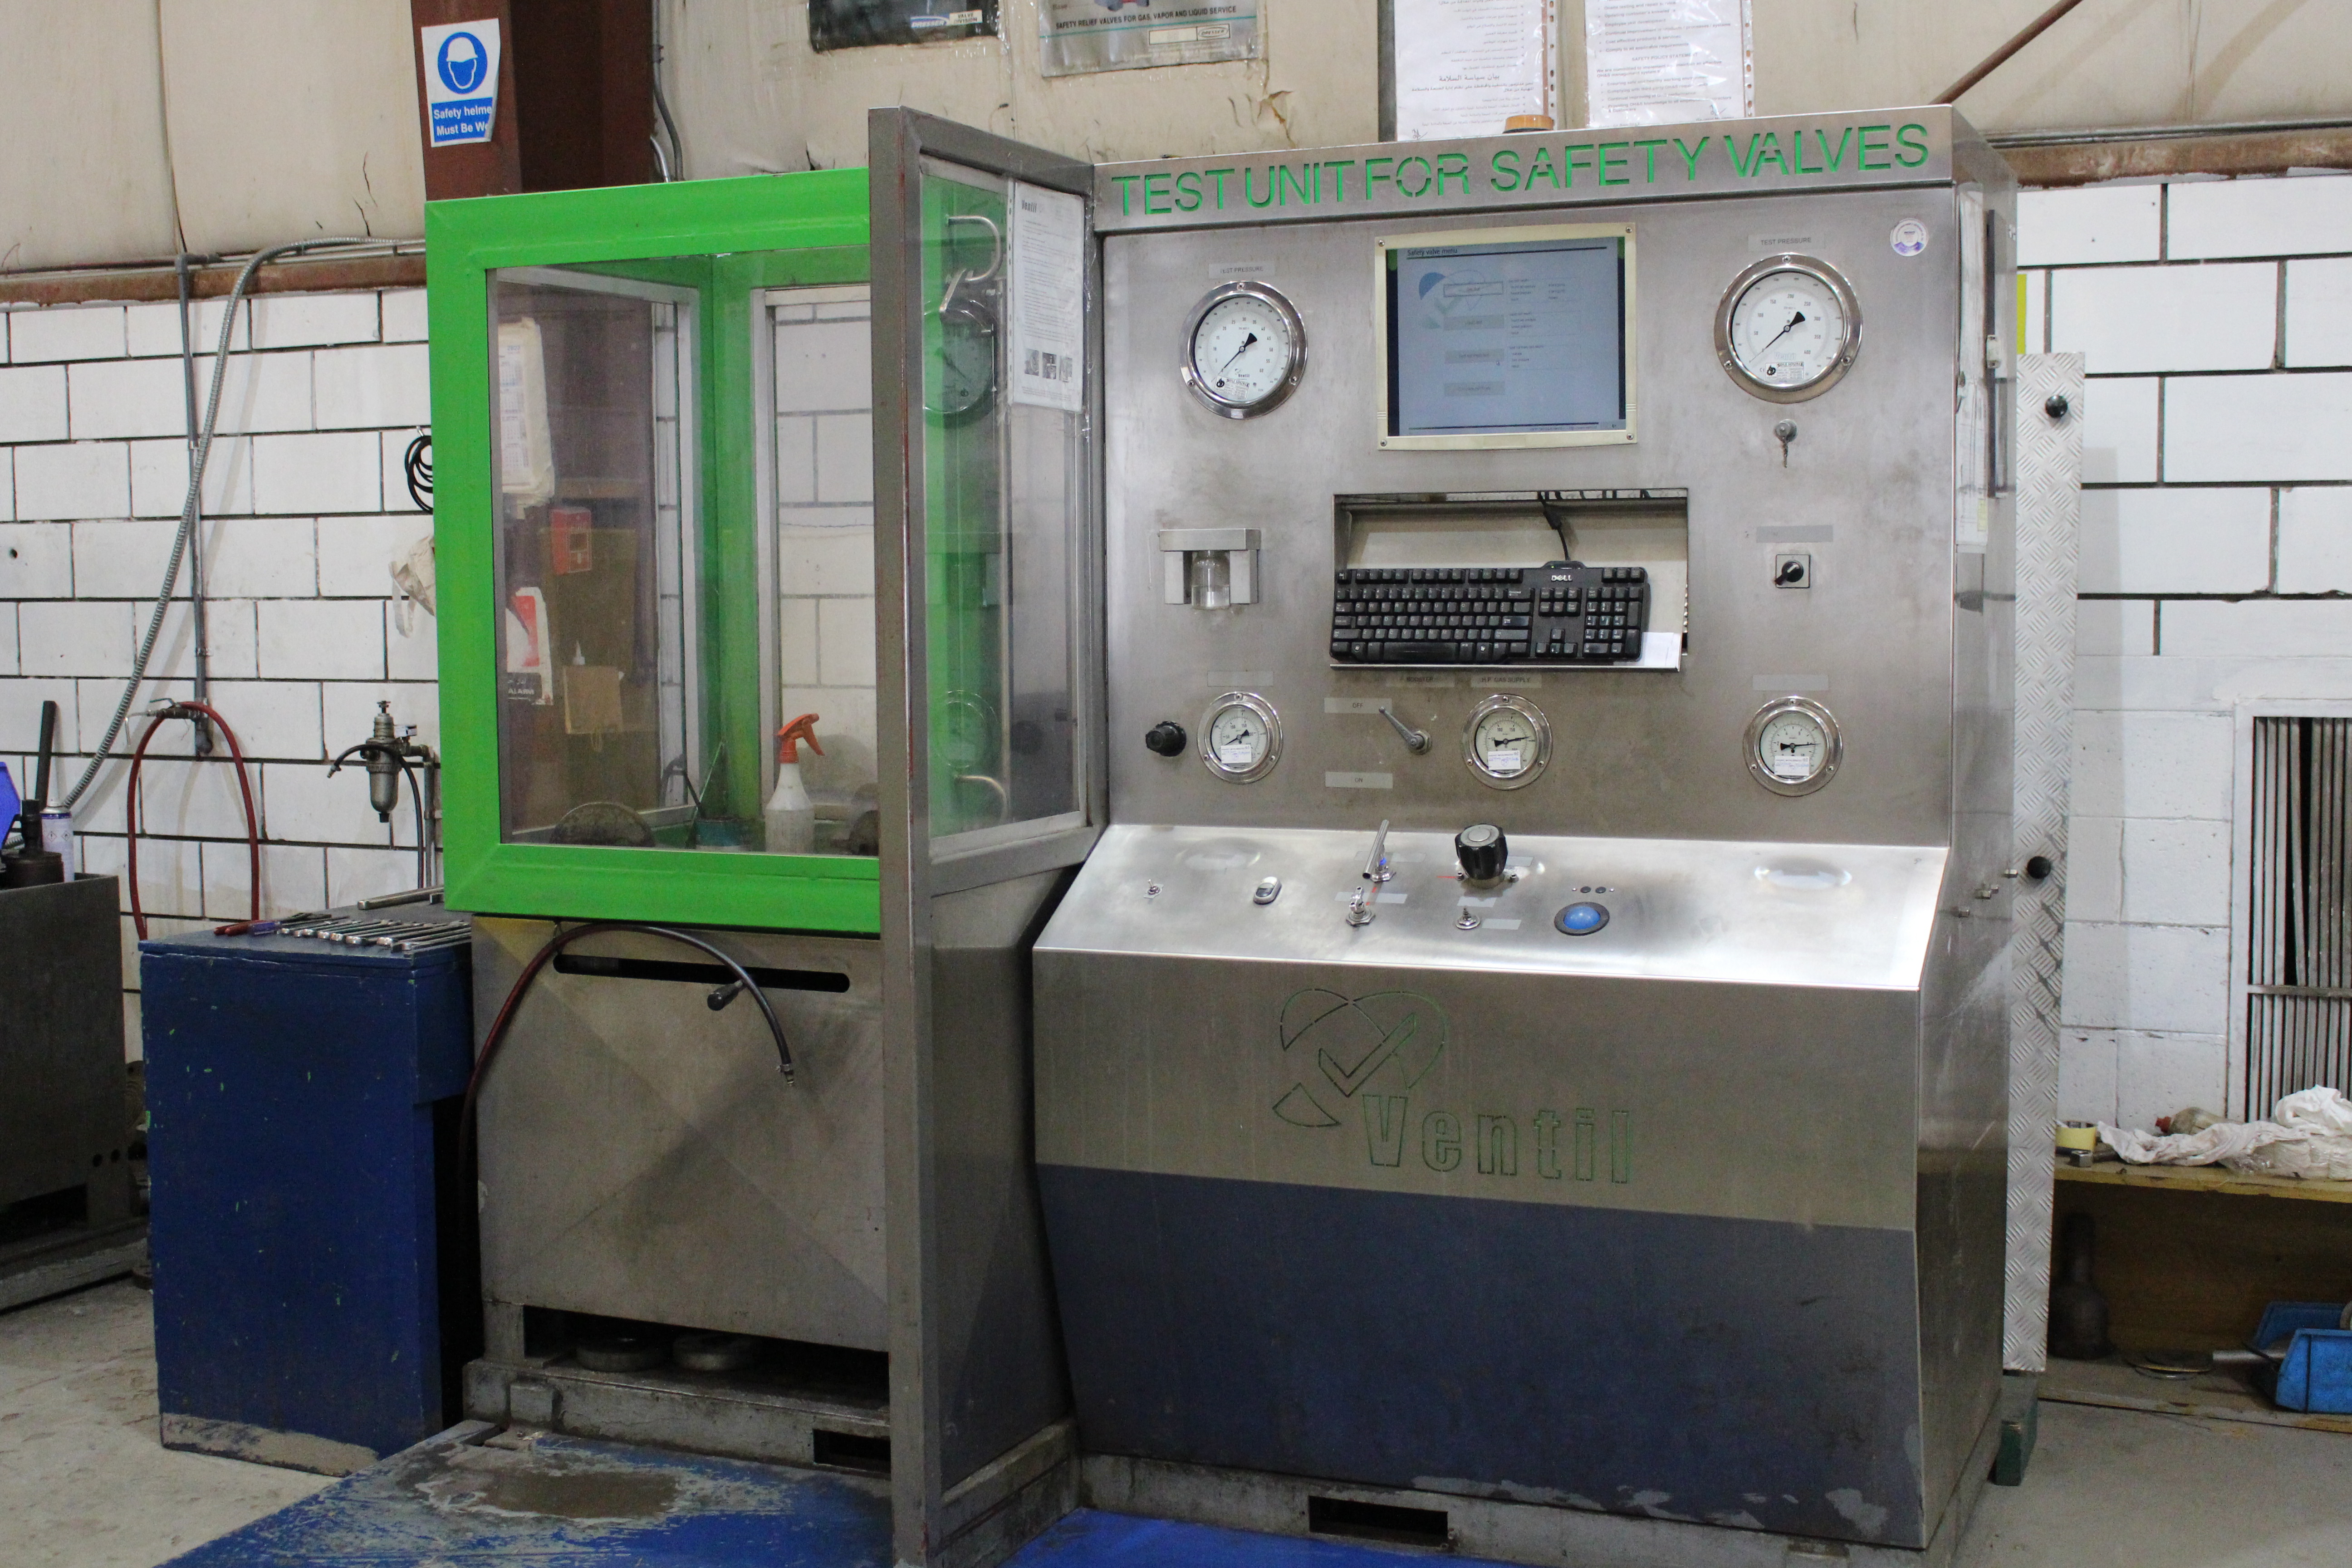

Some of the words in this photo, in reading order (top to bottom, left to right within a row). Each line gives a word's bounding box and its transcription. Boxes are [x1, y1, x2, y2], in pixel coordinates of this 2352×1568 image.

[911, 19, 946, 28] DRESSER
[1056, 21, 1076, 29] SAFETY
[1078, 18, 1097, 26] RELIEF
[1099, 16, 1122, 24] VALVES
[1153, 10, 1173, 19] VAPOR
[1189, 8, 1208, 16] LIQUID
[1210, 5, 1236, 15] SERVICE
[434, 107, 462, 120] Safety
[436, 125, 458, 136] Must
[461, 122, 474, 133] Be
[1112, 168, 1235, 216] TEST
[1245, 160, 1355, 208] UNIT
[1365, 152, 1470, 201] FOR
[1490, 136, 1710, 192] SAFETY
[1724, 123, 1929, 177] VALVES
[1362, 1093, 1630, 1184] Ventil
